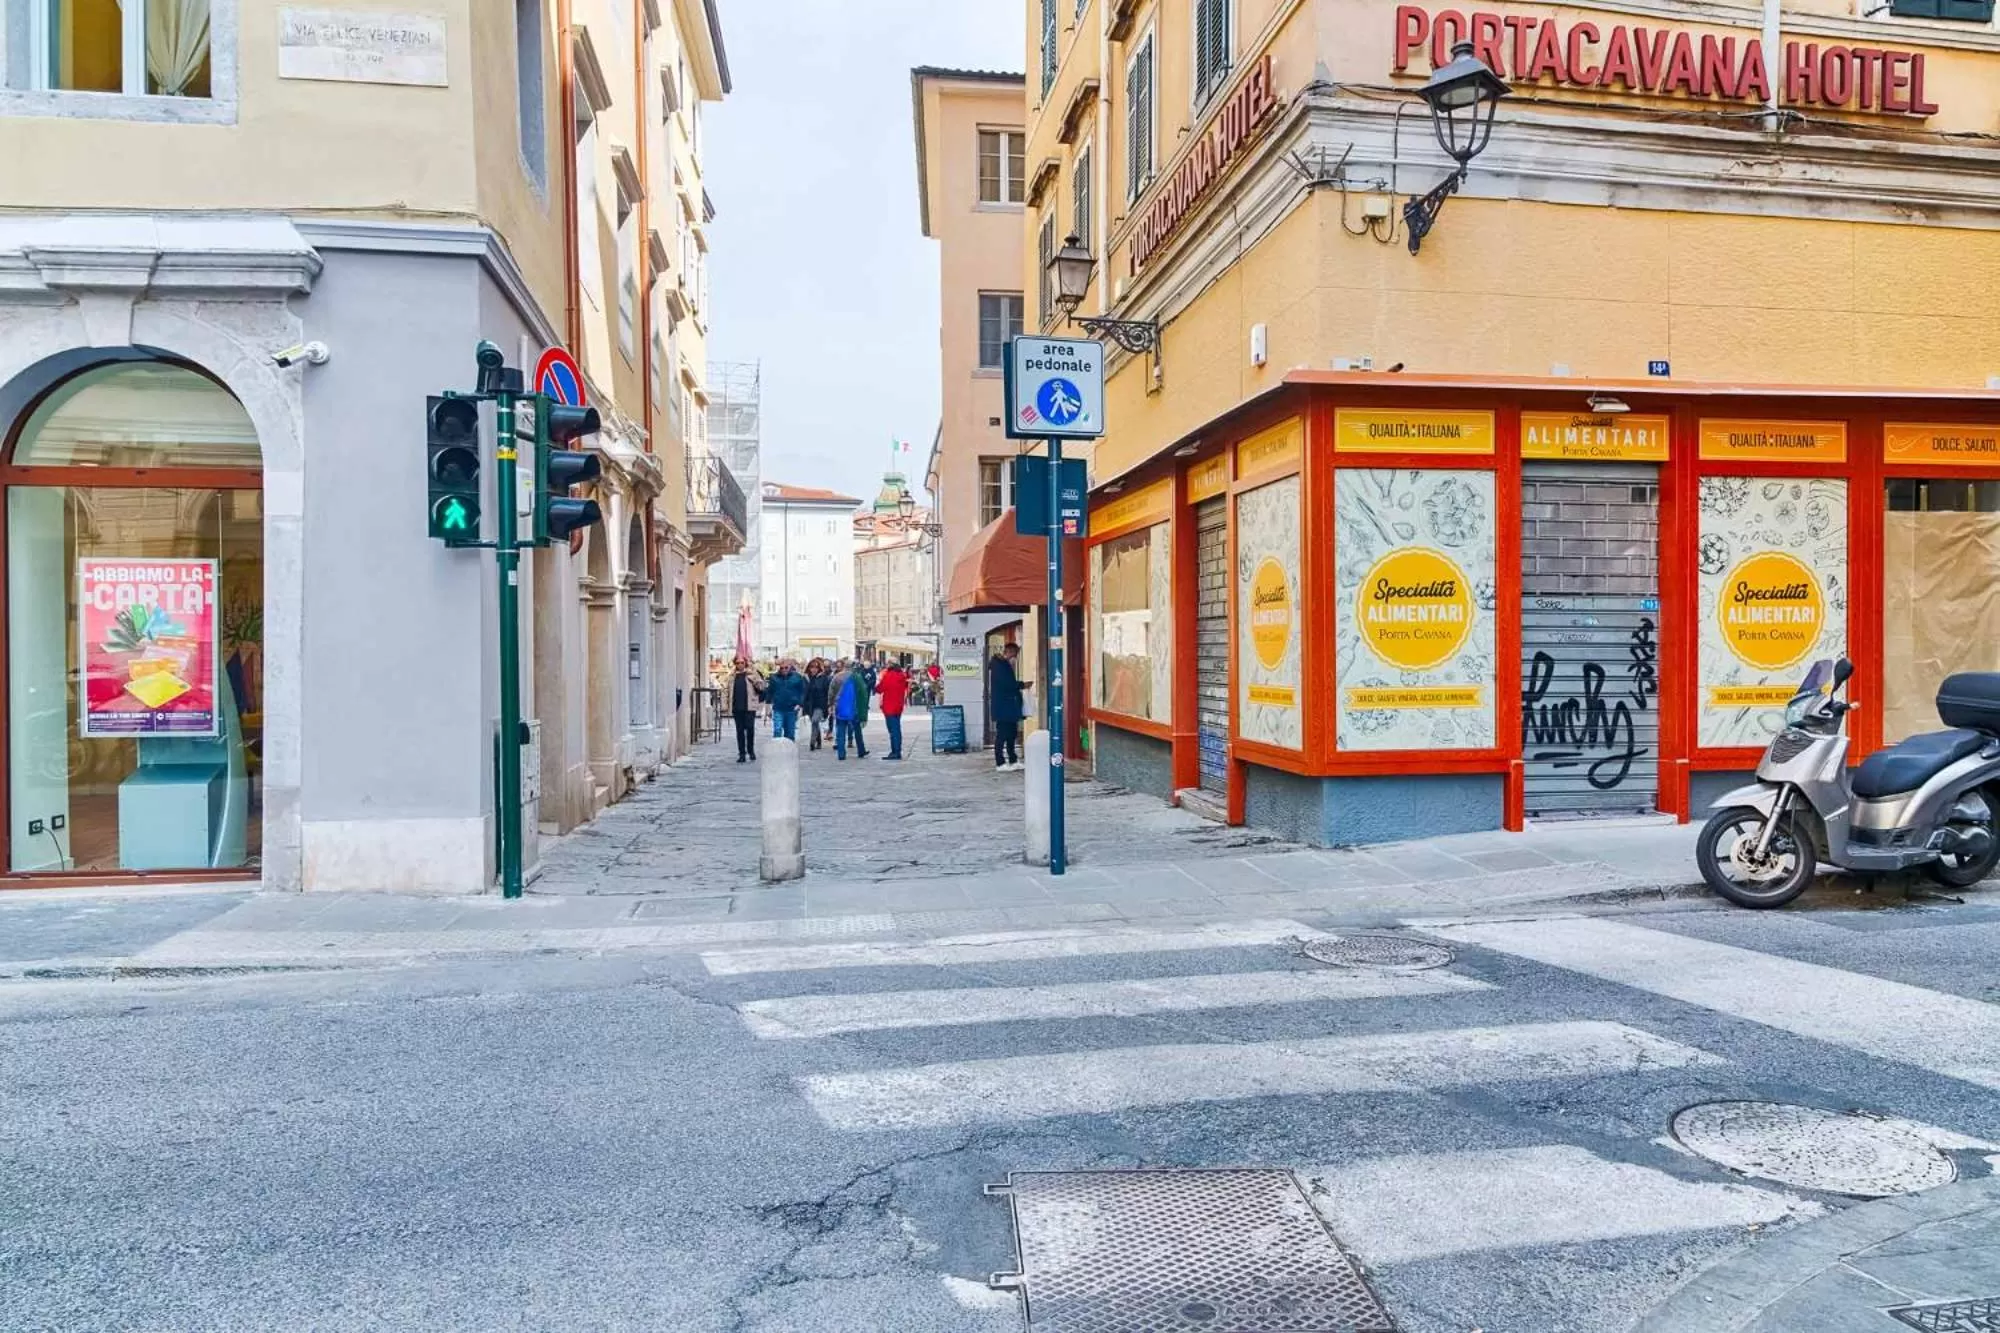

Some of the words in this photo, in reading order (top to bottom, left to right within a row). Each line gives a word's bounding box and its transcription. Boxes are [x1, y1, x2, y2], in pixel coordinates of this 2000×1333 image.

[1395, 6, 1770, 100] PORTACAVANA
[1785, 41, 1938, 114] HOTEL
[1129, 130, 1217, 277] PORTACAVANA
[1217, 54, 1277, 169] HOTEL
[1043, 344, 1074, 356] area
[1026, 358, 1092, 373] pedonale
[1417, 424, 1461, 439] ITALIANA
[1528, 426, 1656, 448] ALIMENTARI
[1775, 433, 1815, 448] ITALIANA
[94, 567, 175, 582] ABBIAMO
[180, 567, 203, 583] LA
[93, 583, 204, 613] CARTA
[1368, 604, 1464, 622] ALIMENTARI
[1728, 606, 1816, 624] ALIMENTARI
